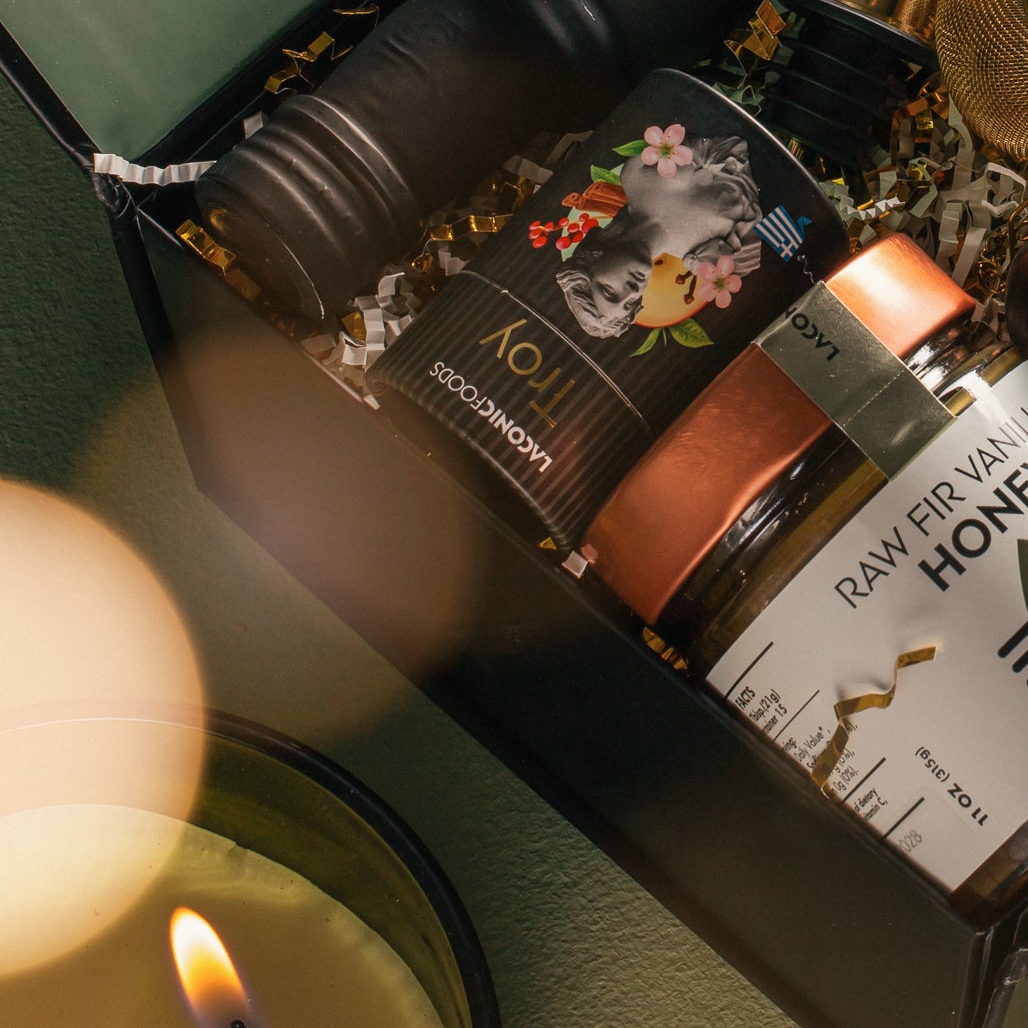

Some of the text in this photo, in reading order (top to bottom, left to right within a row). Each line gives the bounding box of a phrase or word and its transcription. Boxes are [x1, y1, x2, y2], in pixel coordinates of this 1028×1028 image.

[429, 361, 553, 473] LACONICFOODS
[479, 318, 576, 430] Troy
[833, 526, 909, 609] RAW
[906, 481, 967, 537] FIR
[914, 746, 989, 826] 11 OZ (315g)
